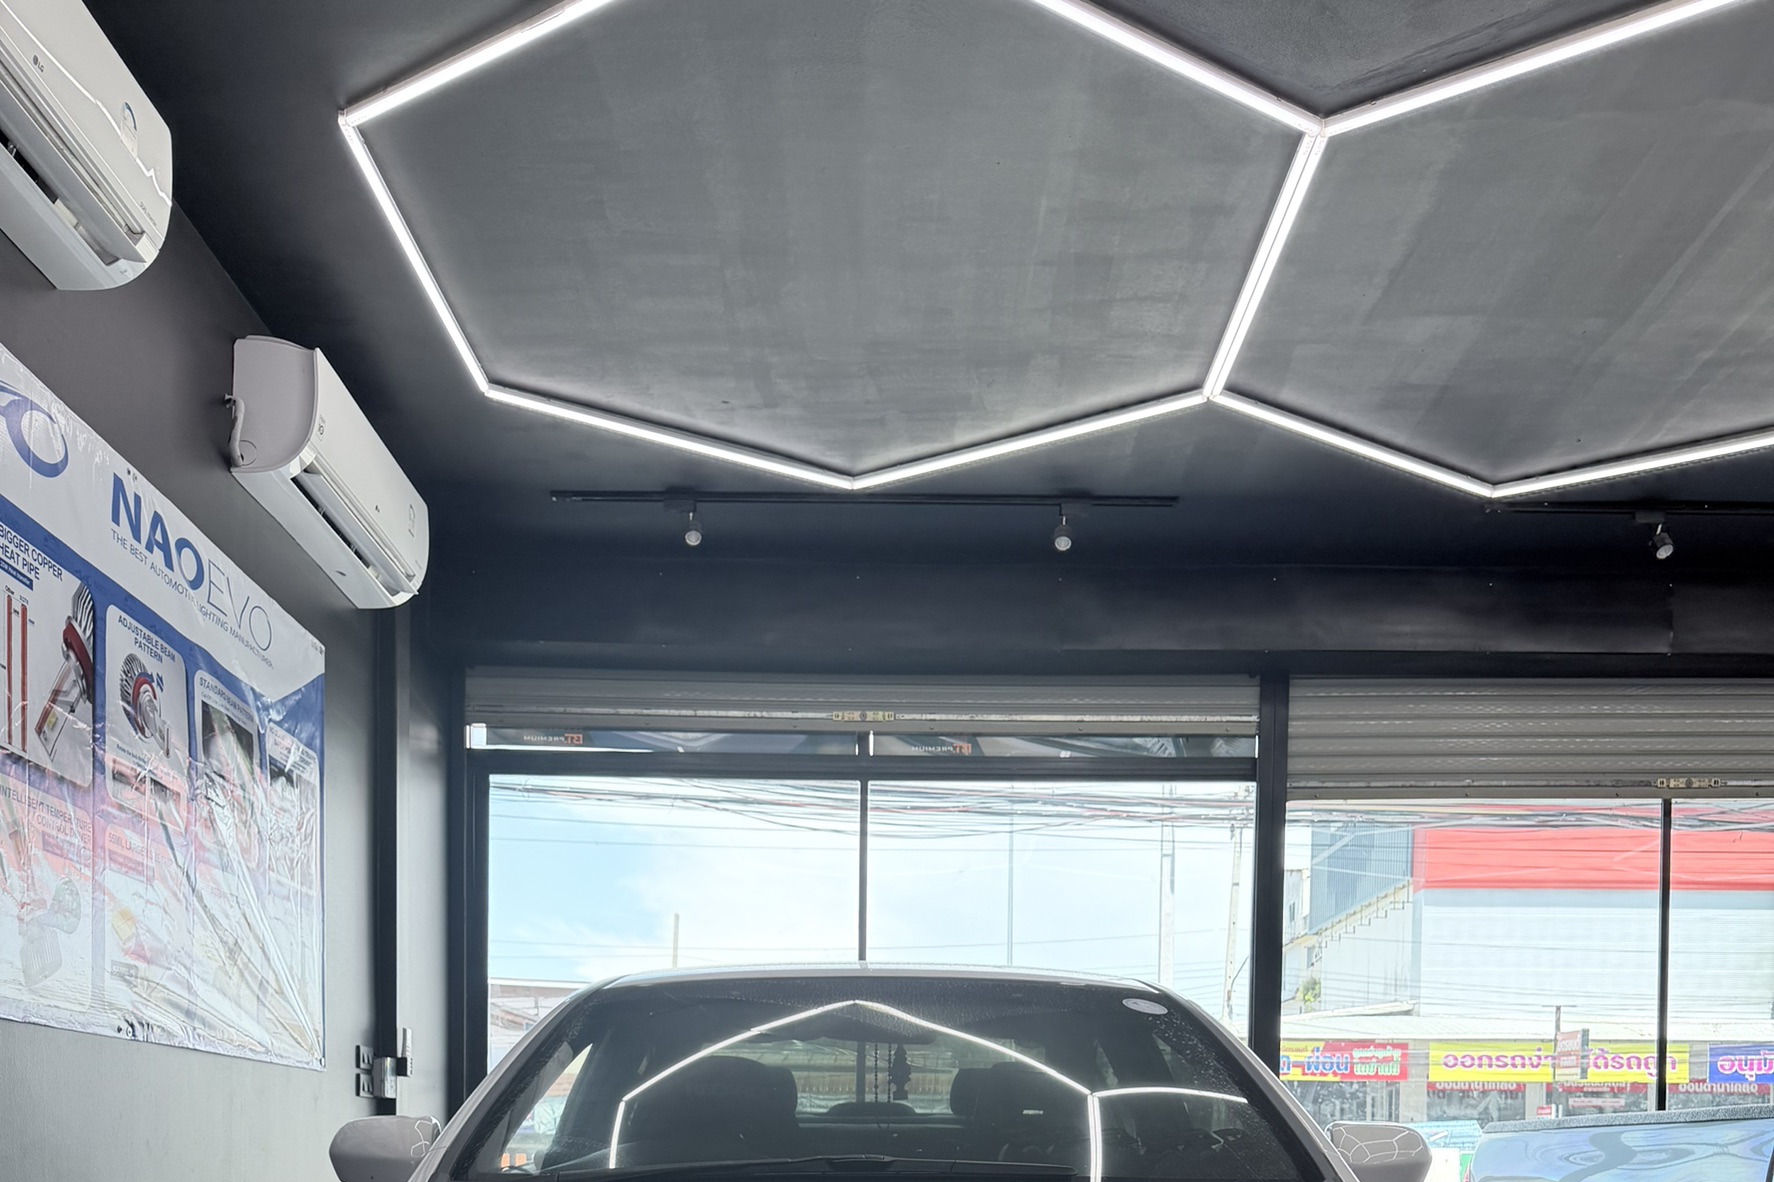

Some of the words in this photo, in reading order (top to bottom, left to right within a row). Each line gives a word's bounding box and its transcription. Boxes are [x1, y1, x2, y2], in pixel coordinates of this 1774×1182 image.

[0, 524, 30, 558] BIGGER
[31, 548, 63, 581] COPPER
[111, 528, 127, 550] THE
[129, 541, 148, 567] BEST
[149, 562, 197, 607] AUTOMOTI
[22, 557, 40, 581] PIPE
[118, 615, 160, 650] ADJUSTABLE
[134, 637, 163, 664] PATTERN
[45, 803, 92, 833] TEMPERTURE
